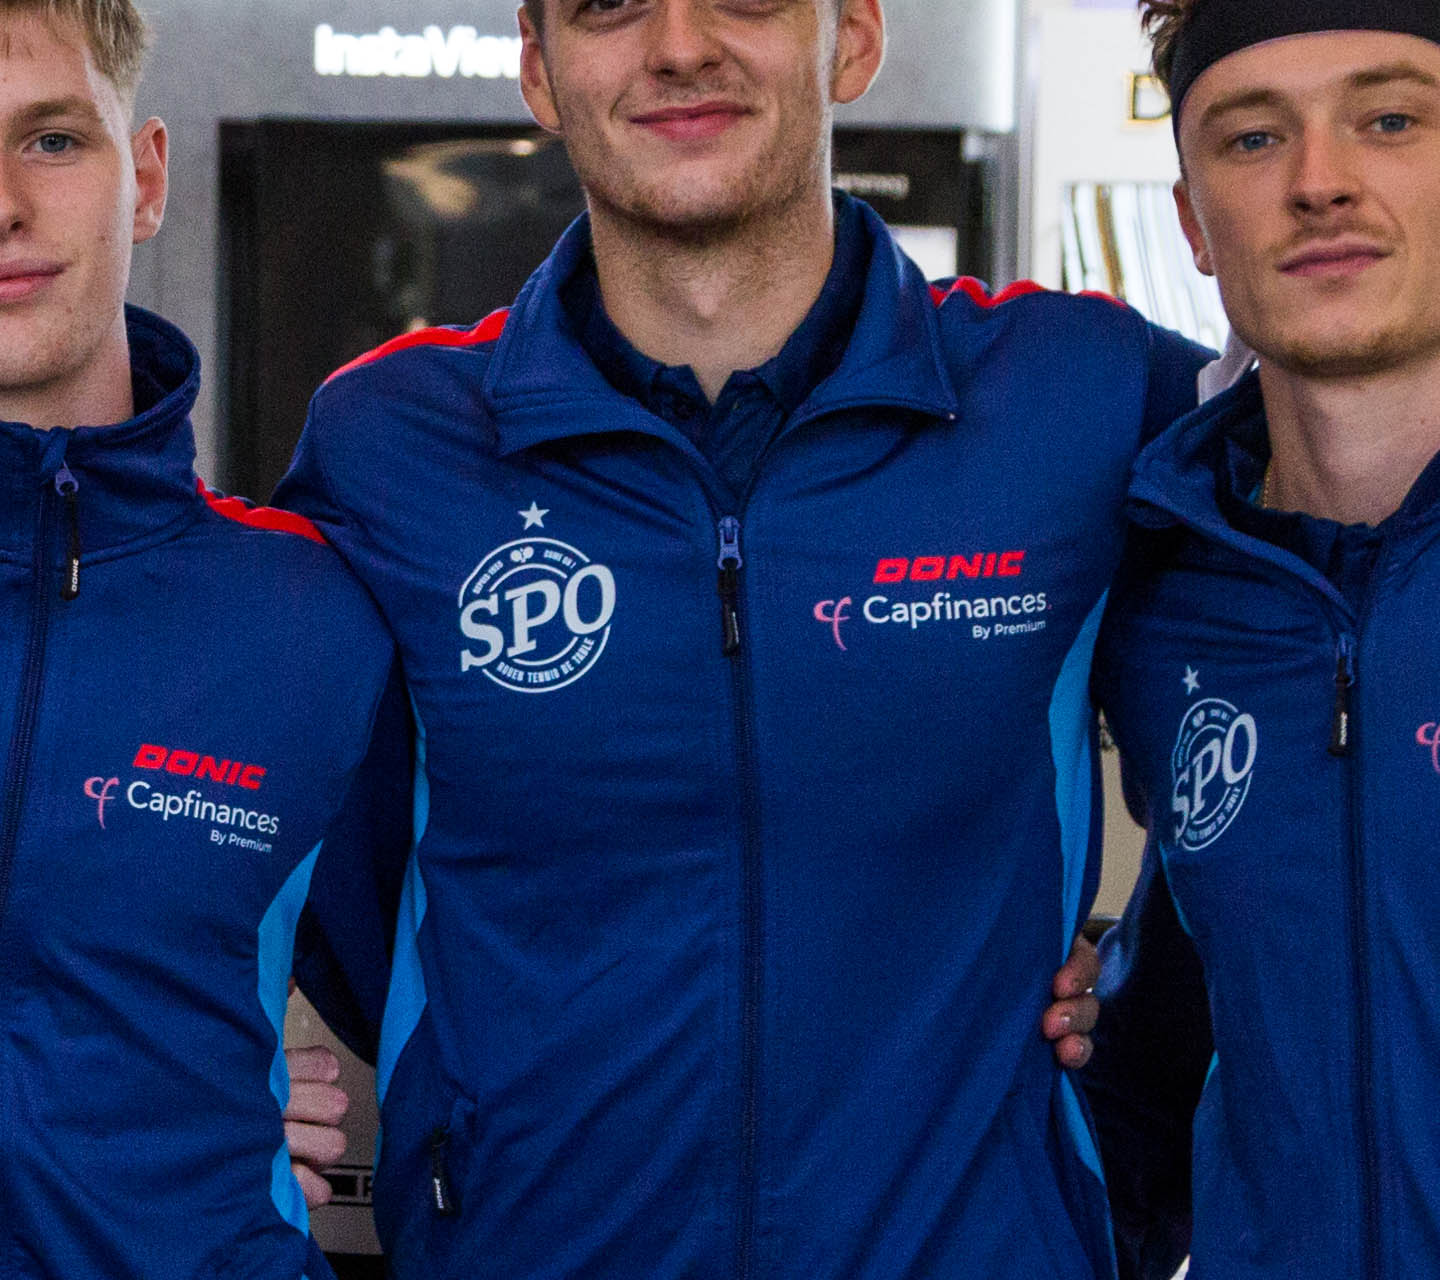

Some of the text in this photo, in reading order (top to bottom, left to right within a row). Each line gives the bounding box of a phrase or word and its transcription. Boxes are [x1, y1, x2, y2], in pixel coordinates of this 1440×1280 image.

[874, 551, 1025, 583] DONIC
[460, 564, 616, 672] SPO
[972, 620, 1046, 640] By Premium
[133, 744, 267, 790] DONIC
[1173, 713, 1257, 846] SPO
[211, 830, 272, 853] By Premium
